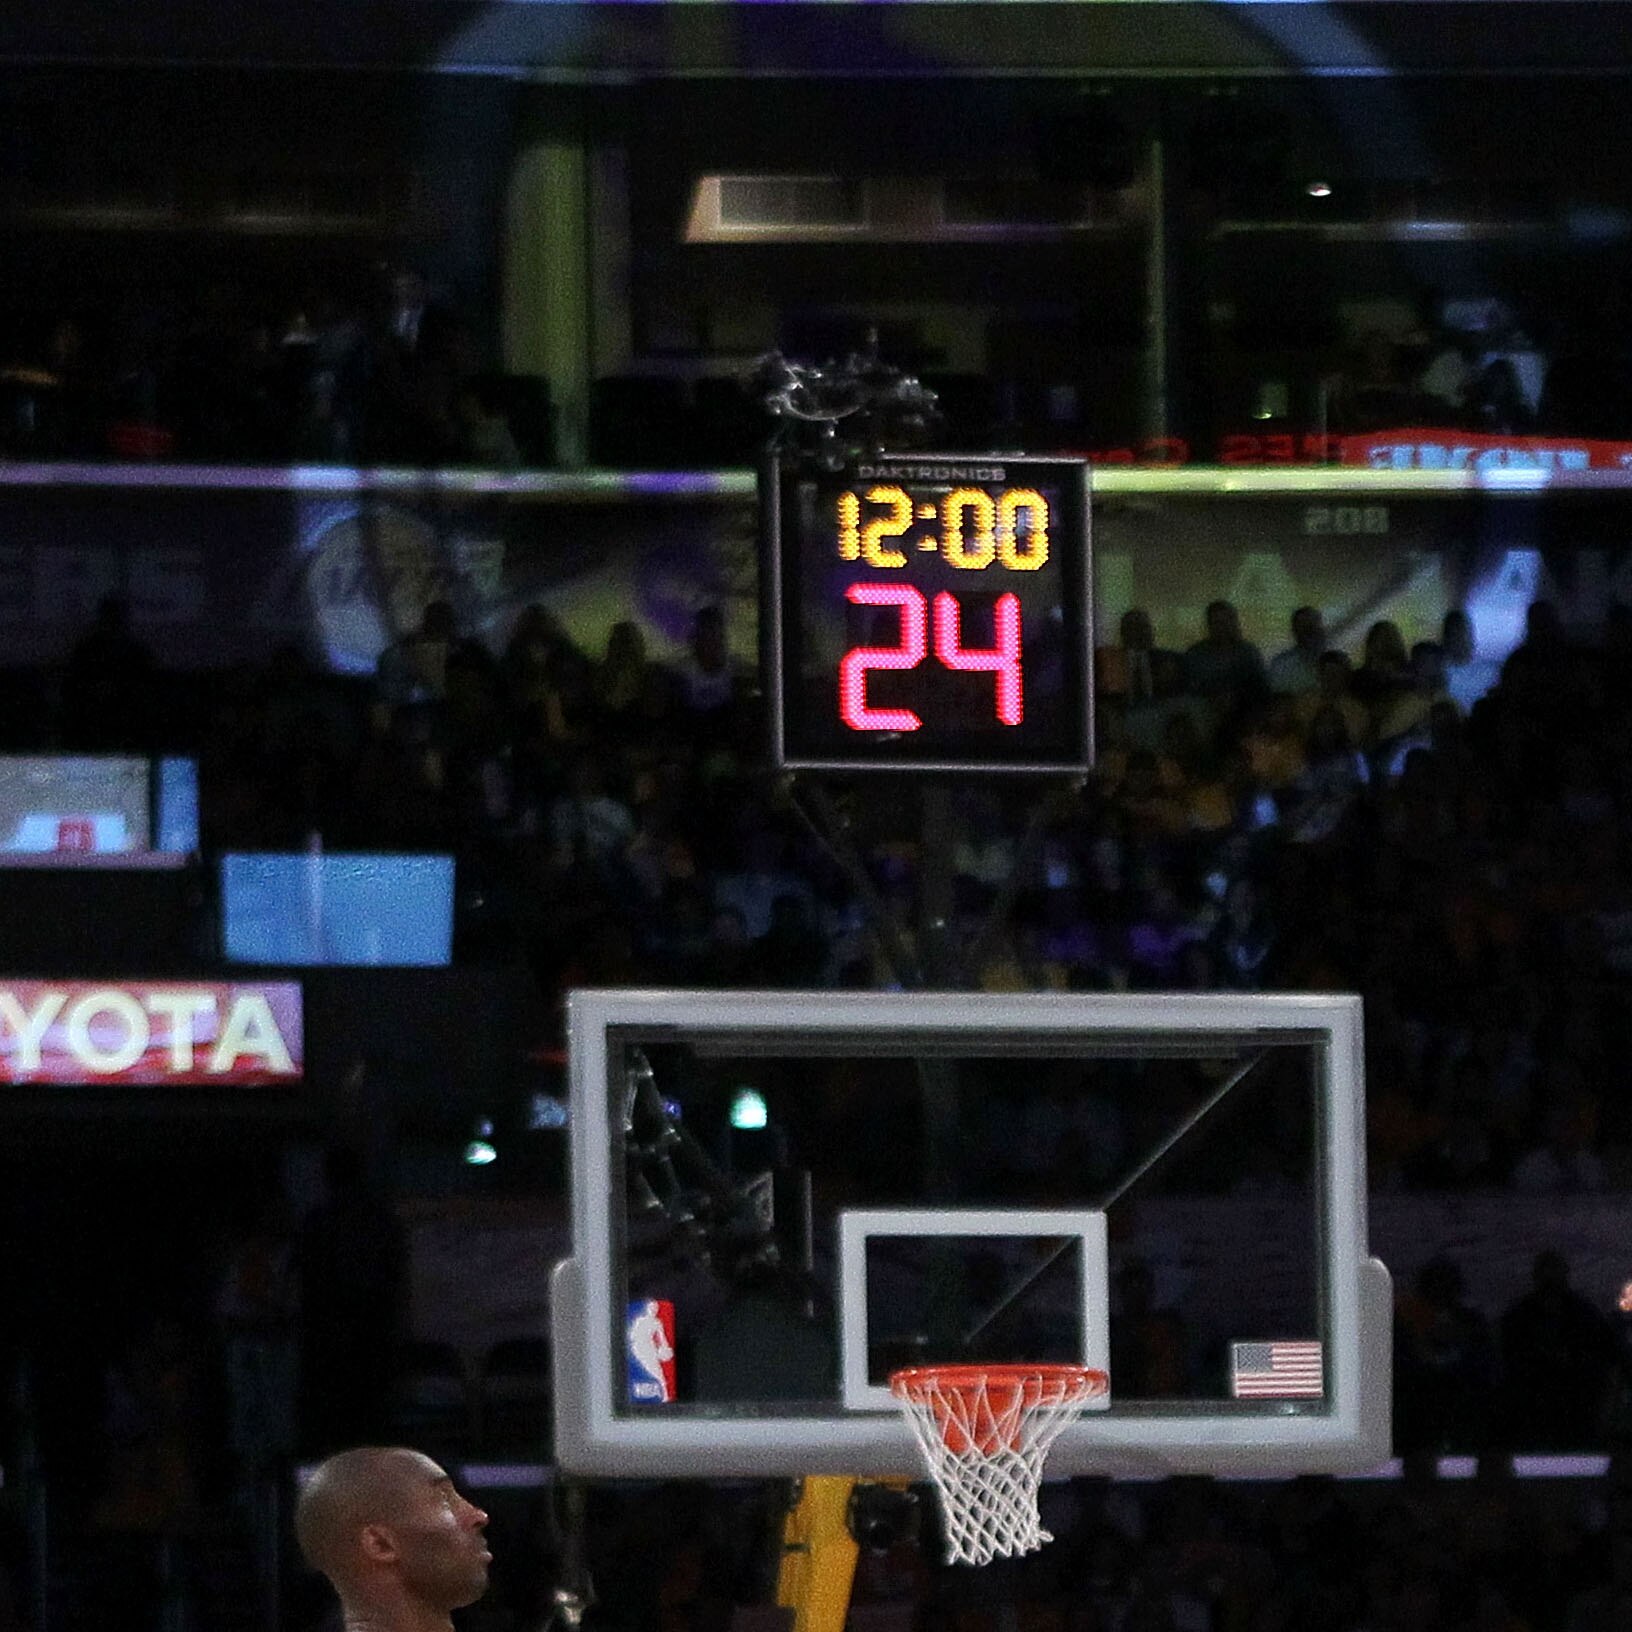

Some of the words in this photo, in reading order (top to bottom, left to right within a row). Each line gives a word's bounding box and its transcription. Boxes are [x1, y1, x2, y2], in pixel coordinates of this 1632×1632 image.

[856, 464, 1008, 482] DAKTRONICS
[837, 482, 1051, 573] 12:00
[838, 582, 1025, 733] 24
[0, 989, 297, 1076] YOTA
